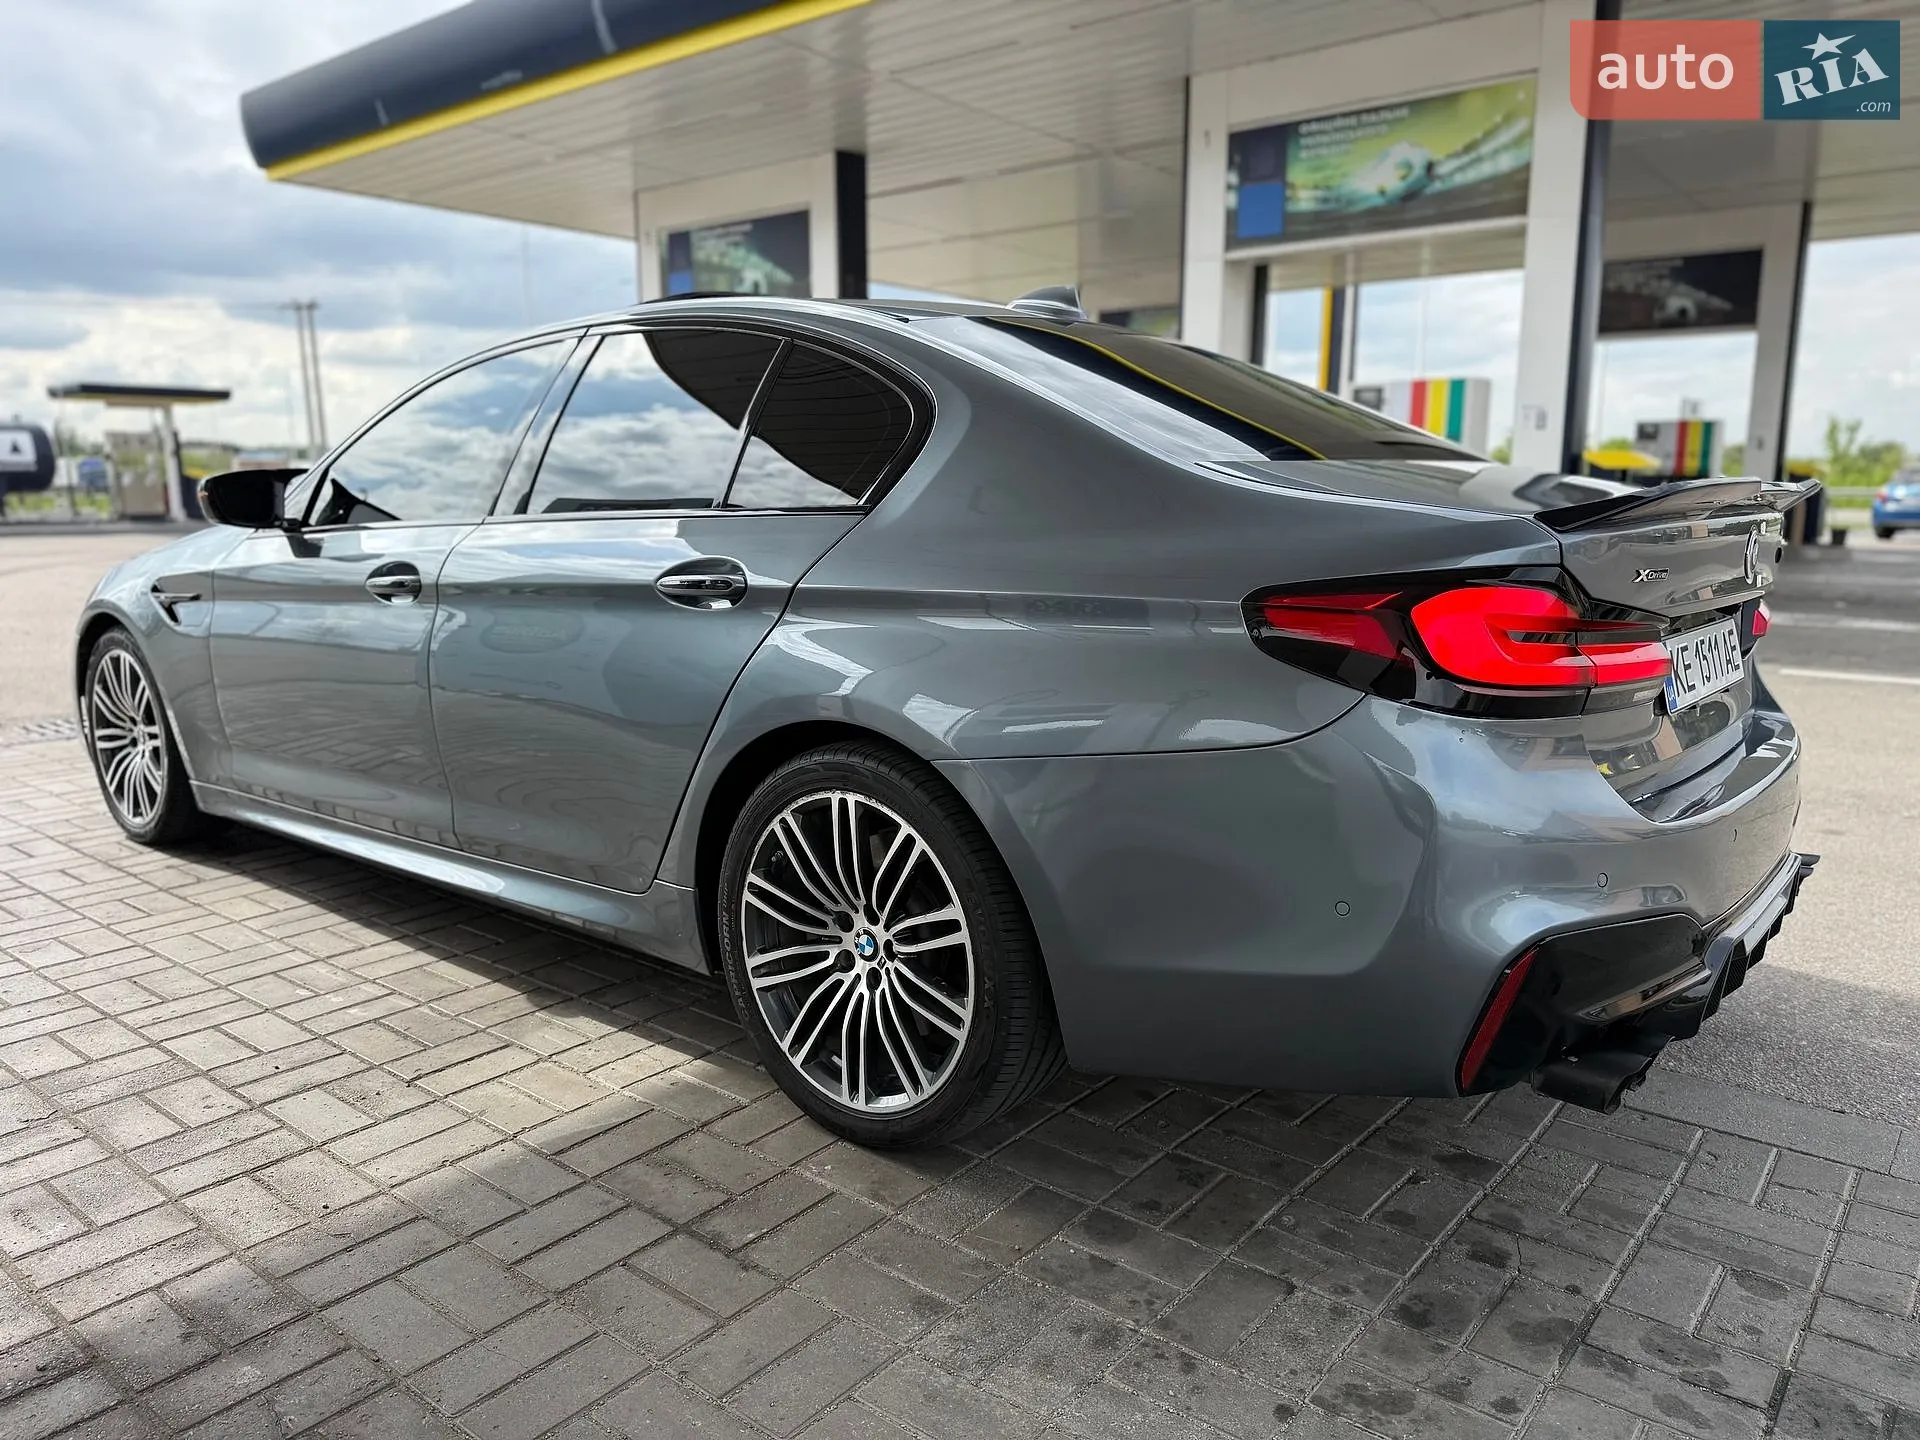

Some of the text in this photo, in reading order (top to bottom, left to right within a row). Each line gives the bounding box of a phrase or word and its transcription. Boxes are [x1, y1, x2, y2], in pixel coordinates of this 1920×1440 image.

[1669, 628, 1741, 698] KE 1511 AE
